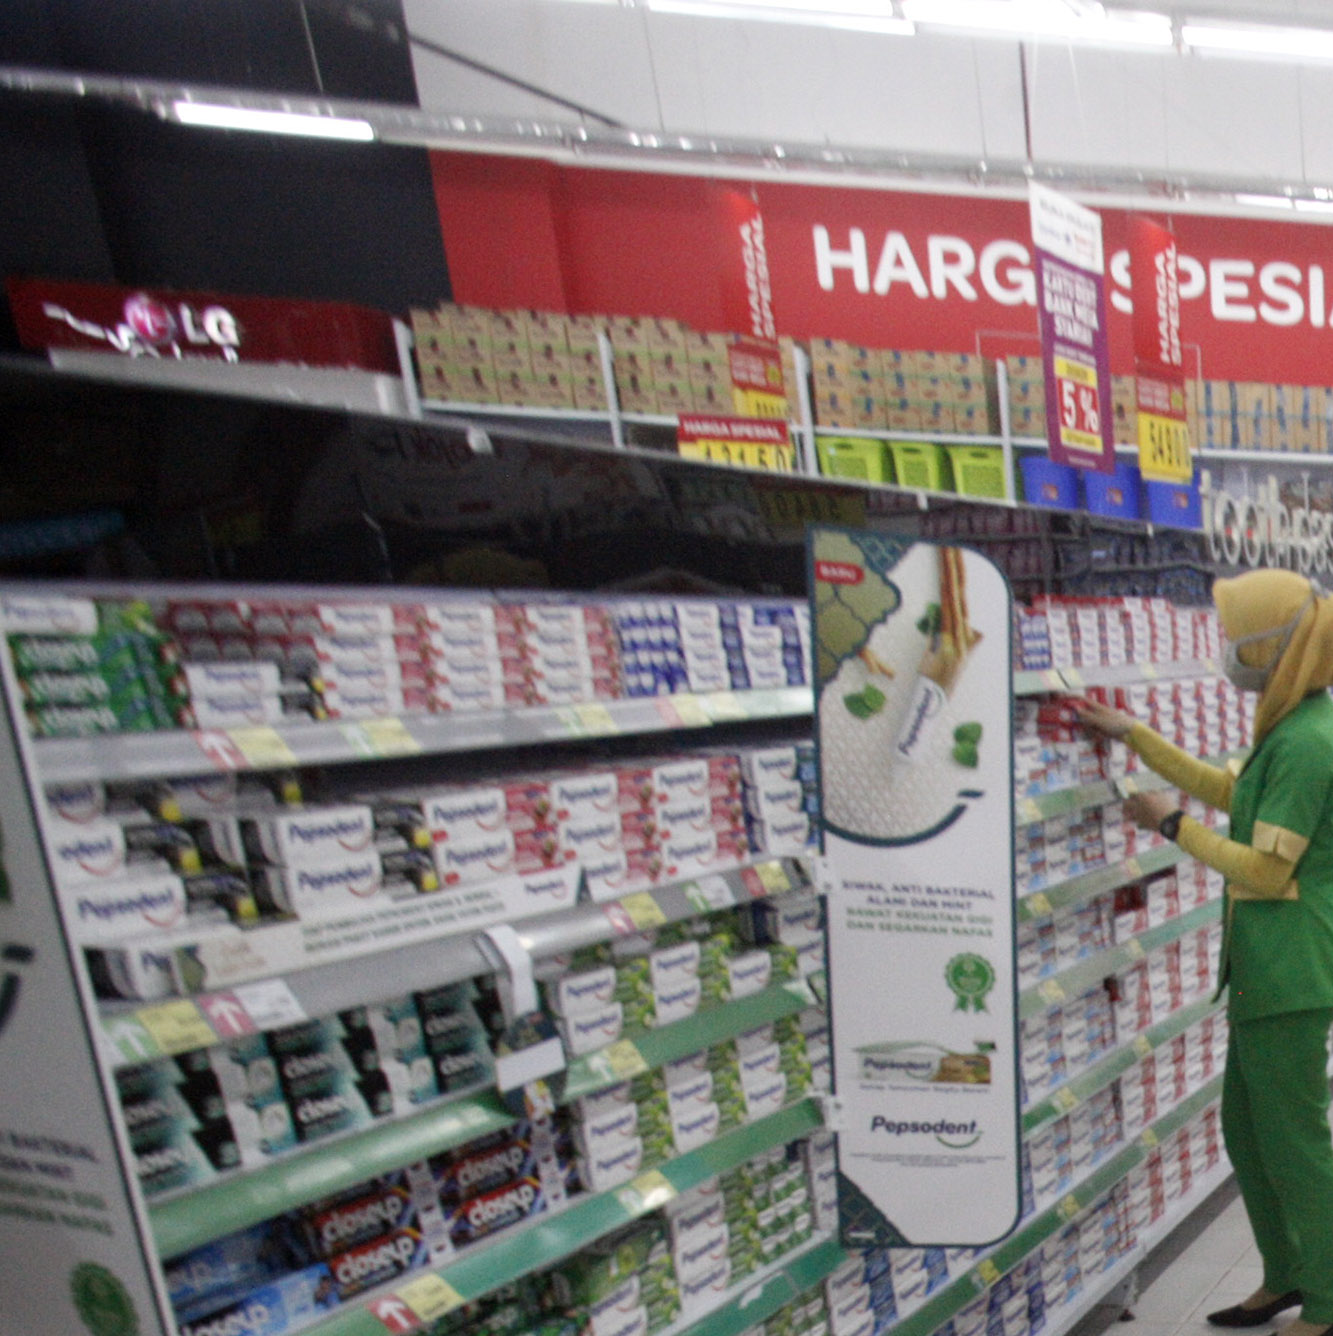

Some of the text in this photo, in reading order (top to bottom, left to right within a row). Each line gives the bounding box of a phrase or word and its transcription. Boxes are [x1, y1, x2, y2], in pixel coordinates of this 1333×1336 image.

[812, 223, 1037, 306] HARG
[179, 302, 240, 347] LG
[683, 420, 731, 438] HARGA
[871, 1114, 978, 1136] Pepsodent
